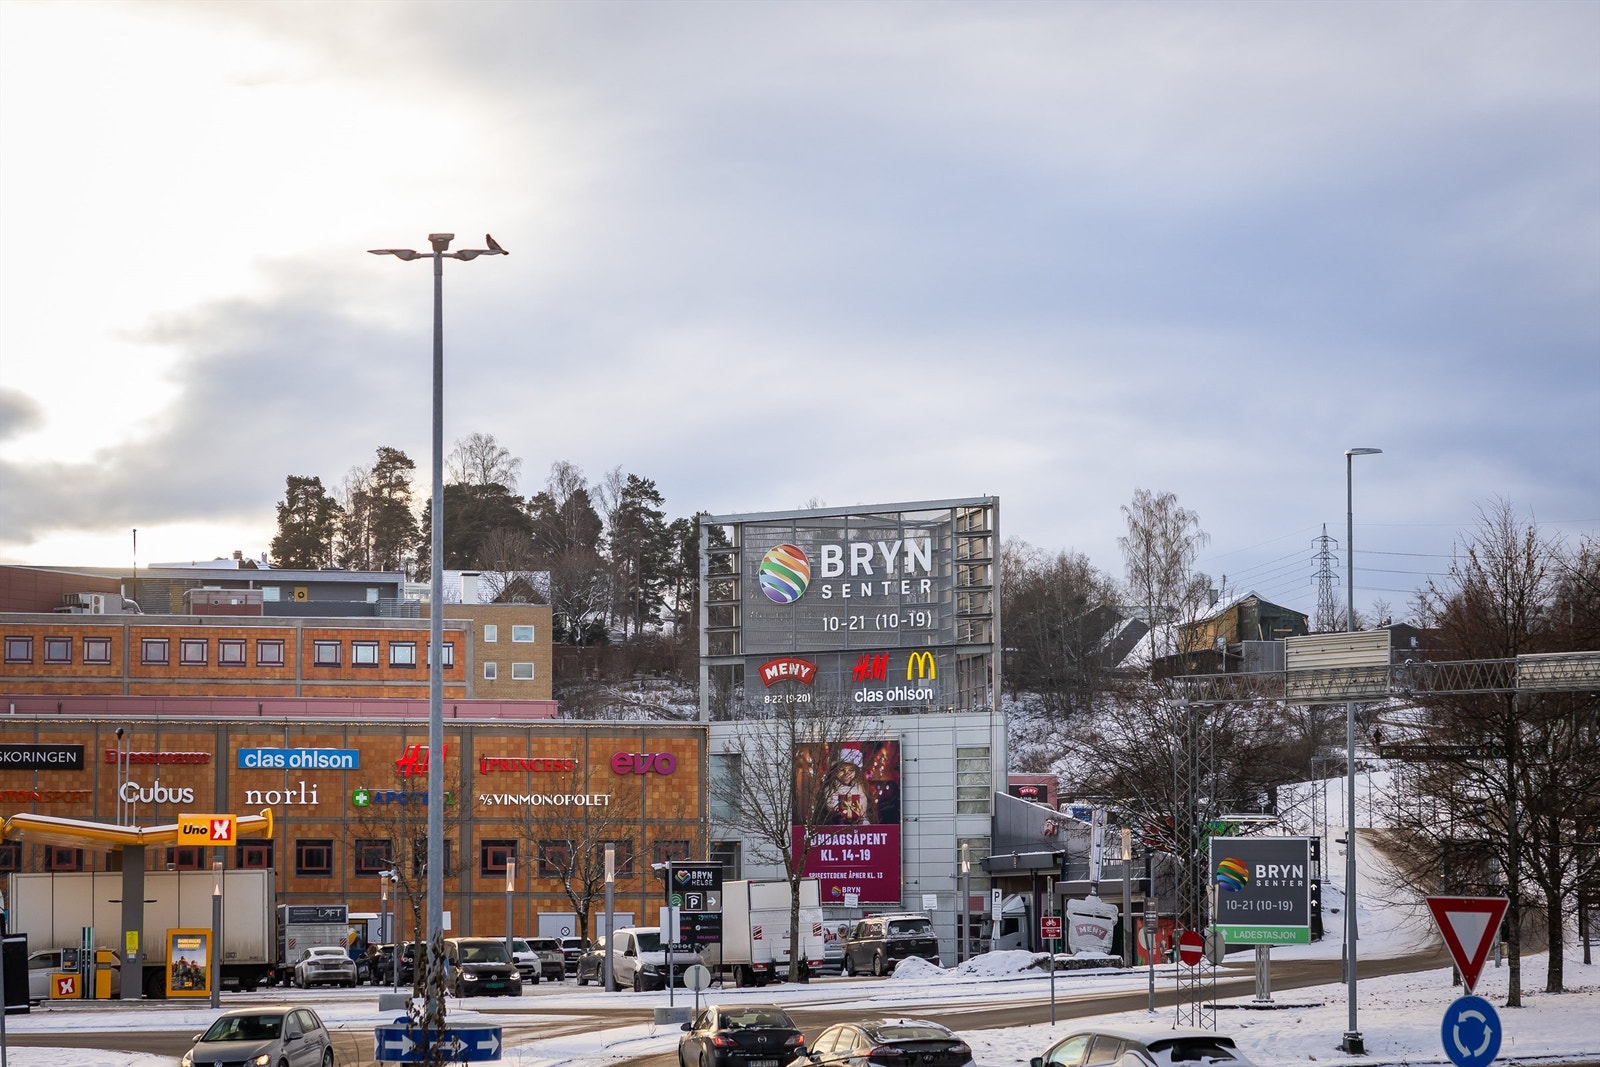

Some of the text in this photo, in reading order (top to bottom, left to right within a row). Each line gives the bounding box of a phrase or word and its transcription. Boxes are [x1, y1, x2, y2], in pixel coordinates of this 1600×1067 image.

[821, 538, 931, 578] BRYN
[821, 579, 931, 599] SENTER
[822, 611, 932, 631] 10-21 (10-19)
[764, 662, 811, 680] MENY
[852, 653, 889, 683] H&M
[764, 695, 782, 704] 8-22
[854, 685, 933, 702] clas ohlson
[105, 749, 211, 764] Dressmann
[244, 750, 353, 768] clas ohlson
[611, 752, 677, 775] evo
[488, 757, 575, 773] PRINCESS
[0, 789, 93, 803] TON SPORT
[119, 780, 195, 804] Cubus
[245, 780, 319, 805] norli
[373, 790, 431, 805] APOTE
[495, 793, 611, 806] VINMONOPOLET
[183, 820, 230, 839] Uno X
[804, 829, 888, 846] ØNDAGSÅPENT
[820, 849, 871, 861] KL. 14-19
[691, 871, 713, 880] BRYN
[848, 870, 867, 879] ÅPNER
[1255, 864, 1304, 879] BRYN
[994, 891, 1000, 902] P
[1226, 900, 1293, 912] 10-21 (10-19)
[1079, 925, 1105, 936] MENY
[1233, 930, 1296, 940] LADESTASJON
